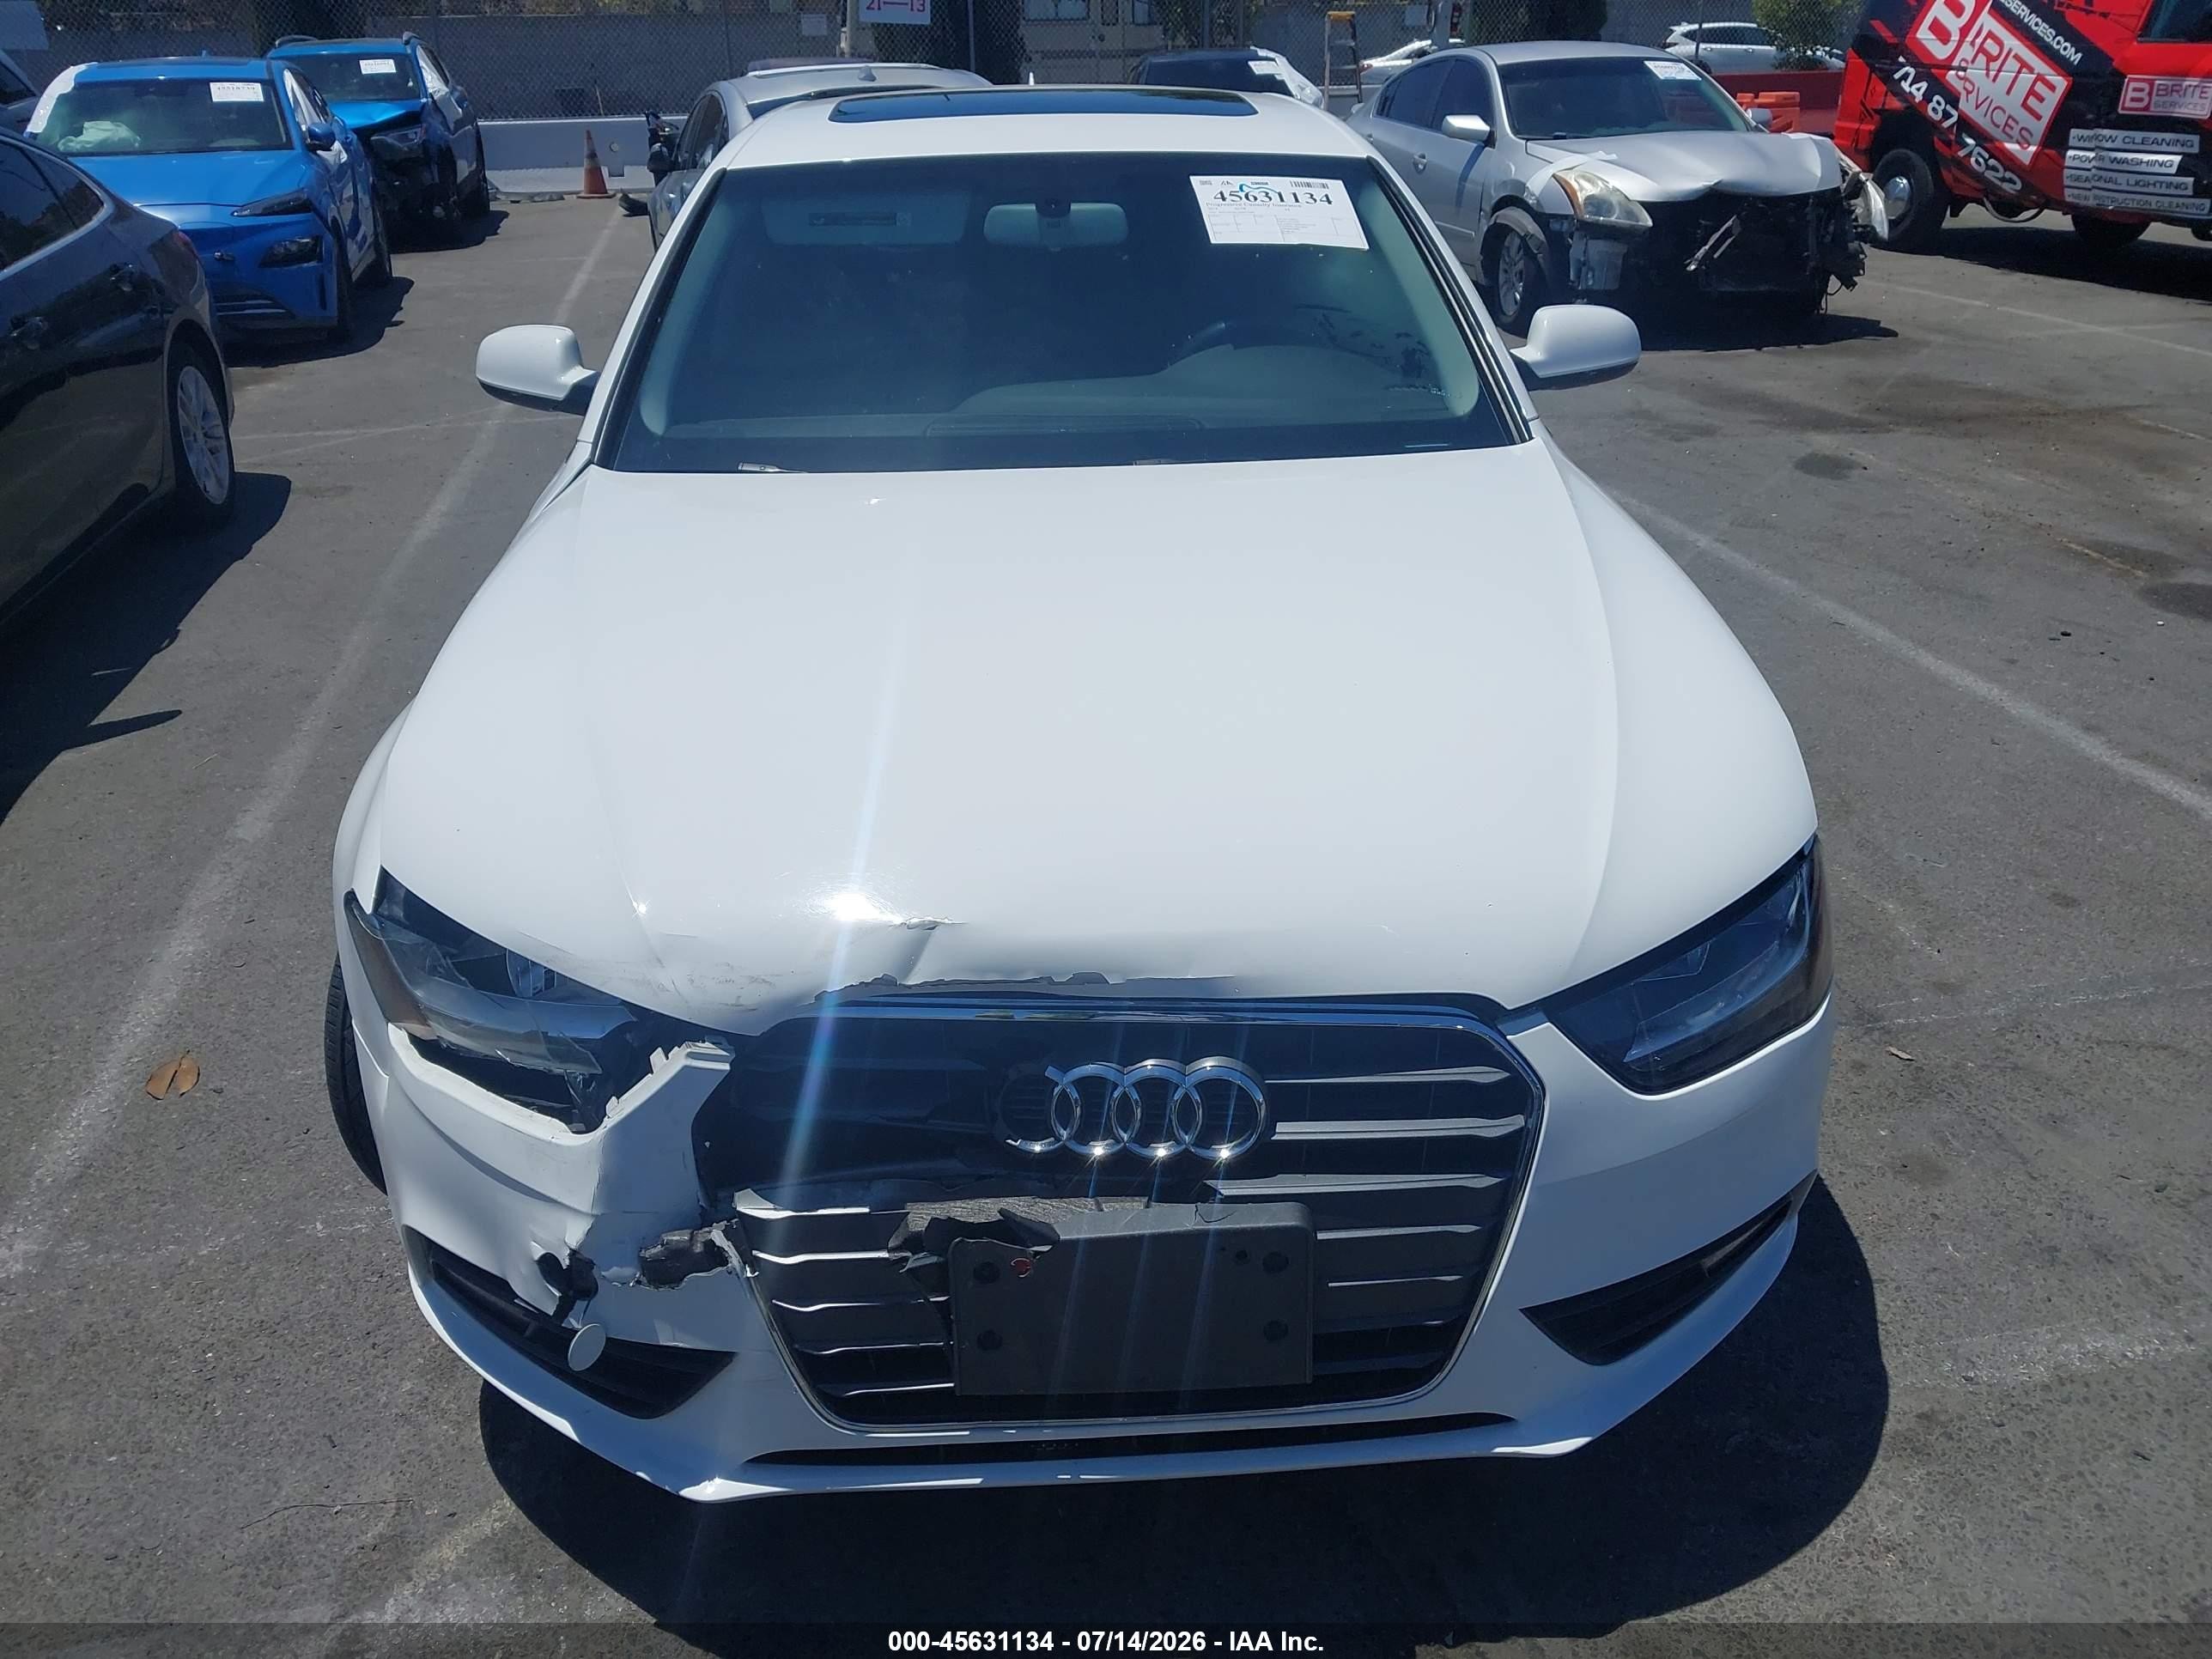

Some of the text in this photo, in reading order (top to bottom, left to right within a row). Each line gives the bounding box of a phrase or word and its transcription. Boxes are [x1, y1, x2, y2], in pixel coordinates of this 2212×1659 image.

[2155, 82, 2210, 100] BRITE
[1955, 58, 2033, 150] SRVICES
[2153, 100, 2207, 112] SERVICES
[1927, 94, 1959, 135] 87
[1958, 132, 2022, 194] 7622
[2122, 136, 2195, 149] CLEANING
[2109, 155, 2174, 168] WASHING
[2126, 178, 2188, 191] LIGHTING
[1213, 190, 1334, 205] 45631134
[2155, 200, 2206, 212] CLEANING
